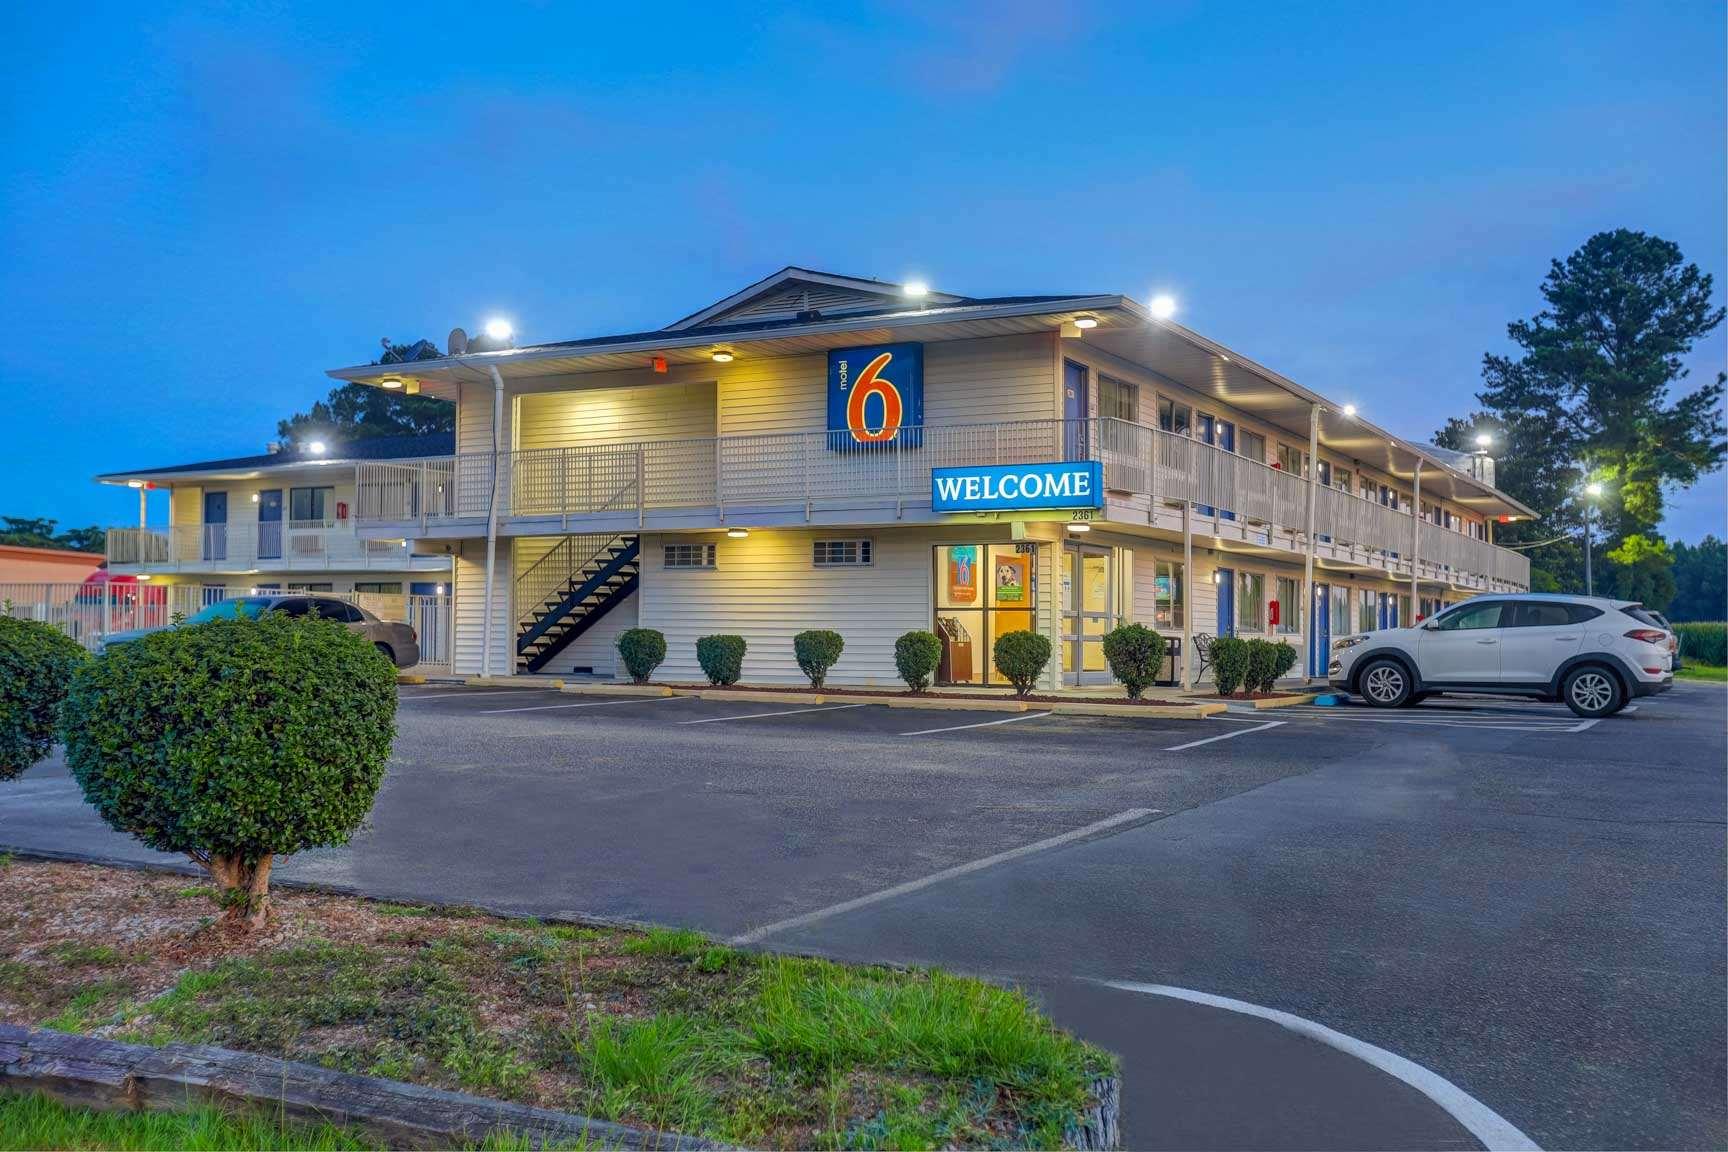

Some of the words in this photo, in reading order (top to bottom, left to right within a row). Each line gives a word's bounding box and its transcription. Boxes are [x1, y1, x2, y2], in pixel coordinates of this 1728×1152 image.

[839, 360, 848, 390] motel
[847, 352, 902, 442] 6
[935, 471, 1091, 502] WELCOME
[1072, 511, 1094, 521] 2361
